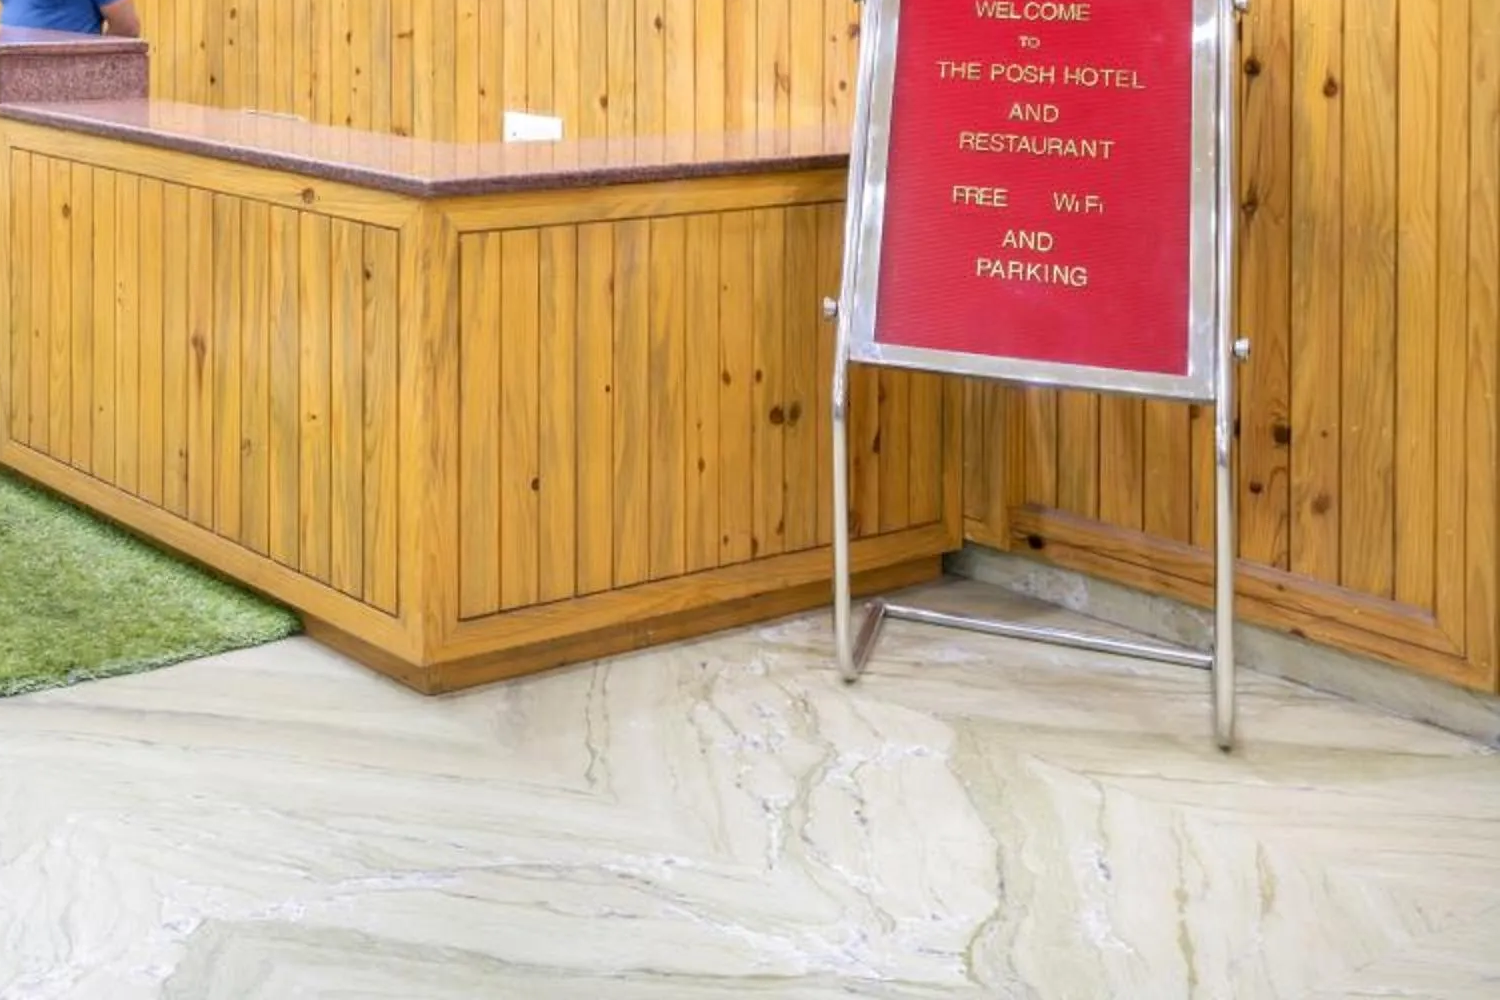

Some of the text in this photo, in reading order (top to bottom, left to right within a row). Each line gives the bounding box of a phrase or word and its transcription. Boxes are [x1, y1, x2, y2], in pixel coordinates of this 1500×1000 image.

[975, 0, 1092, 22] WELCOME
[1018, 35, 1041, 50] TO
[937, 60, 1146, 90] THE POSH HOTEL
[1008, 103, 1060, 123] AND
[959, 132, 1116, 160] RESTAURANT
[952, 185, 1009, 208] FREE
[1002, 229, 1054, 252] AND
[976, 258, 1089, 288] PARKING
